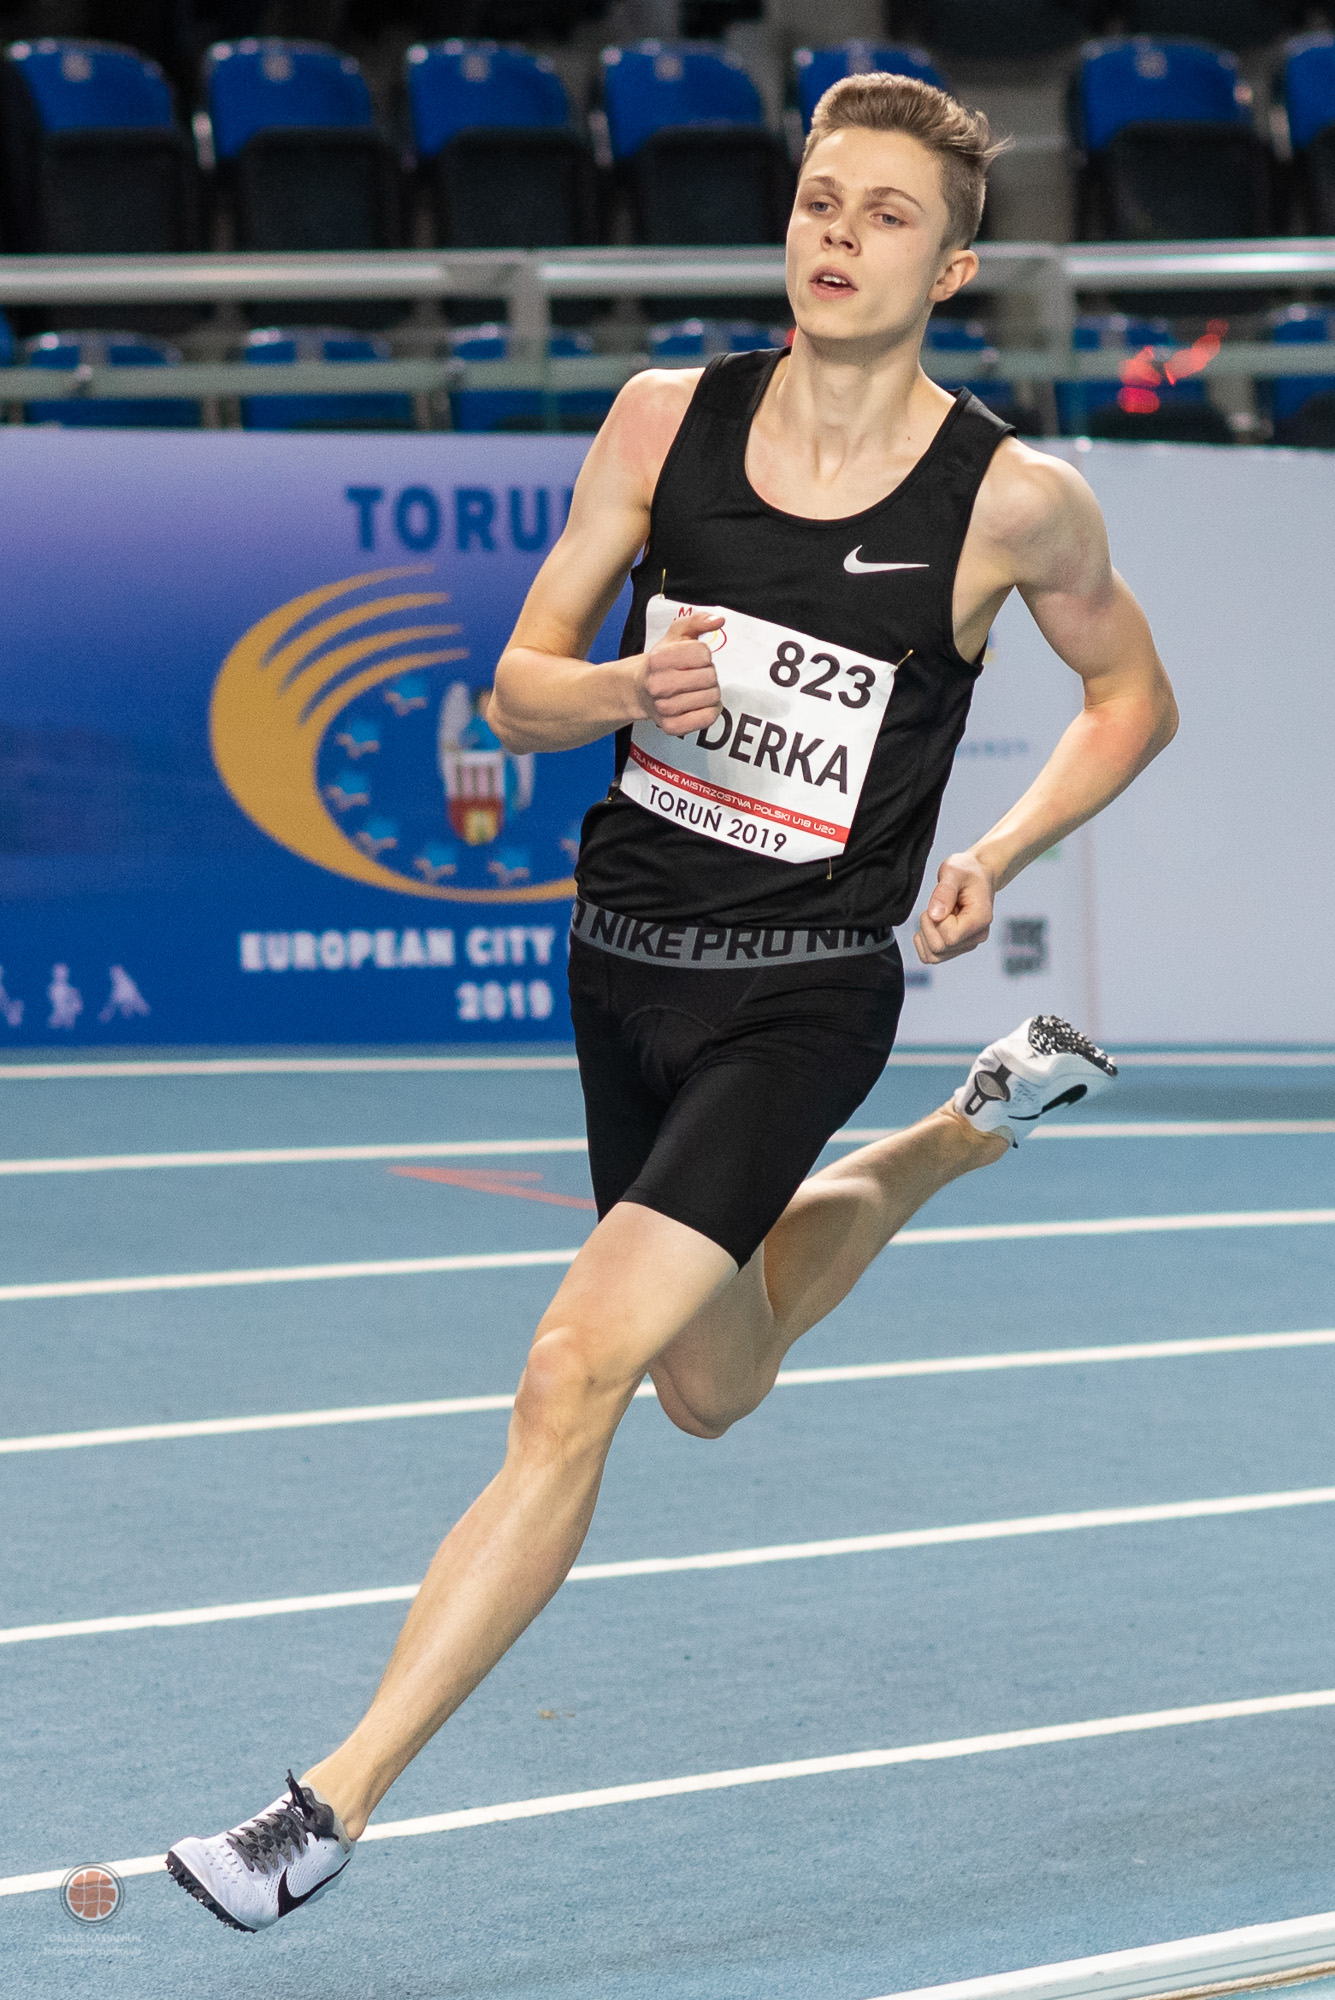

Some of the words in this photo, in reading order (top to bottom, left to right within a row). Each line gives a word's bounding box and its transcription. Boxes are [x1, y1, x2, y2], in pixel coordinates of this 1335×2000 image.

[346, 484, 574, 552] TORU
[769, 640, 876, 709] 823
[656, 705, 848, 795] DERKA
[647, 760, 680, 783] HALOWE
[680, 777, 752, 809] MISTRZOSTWA
[753, 803, 791, 822] POLSKI
[792, 816, 812, 829] U18
[813, 822, 836, 835] U20
[649, 784, 723, 833] TORUŃ
[726, 818, 788, 853] 2019
[240, 930, 456, 971] EUROPEAN
[465, 926, 555, 967] CITY
[588, 908, 687, 960] NIKE
[691, 926, 795, 962] PRO
[457, 980, 554, 1022] 2019
